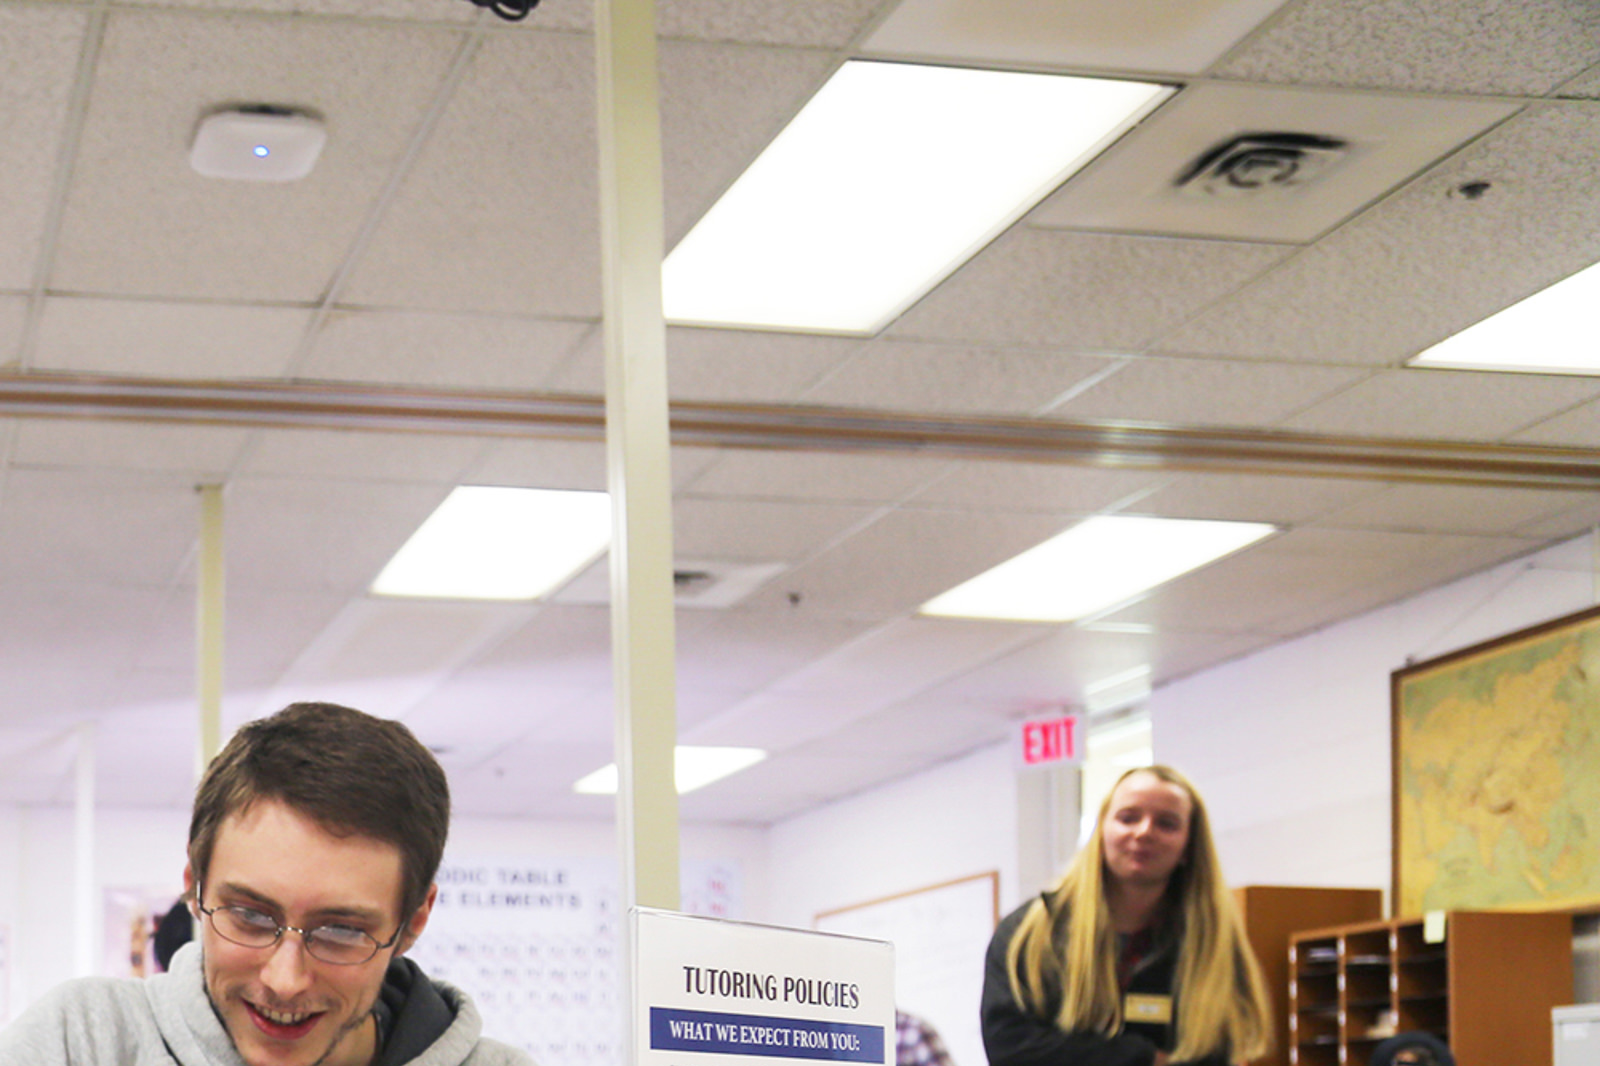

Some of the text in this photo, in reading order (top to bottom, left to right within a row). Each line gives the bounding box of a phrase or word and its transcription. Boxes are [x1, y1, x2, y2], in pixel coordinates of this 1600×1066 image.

[1022, 716, 1077, 765] EXIT
[683, 966, 860, 1009] TUTORING POLICIES
[668, 1020, 860, 1051] WHAT WE EXPECT FROM YOU:
